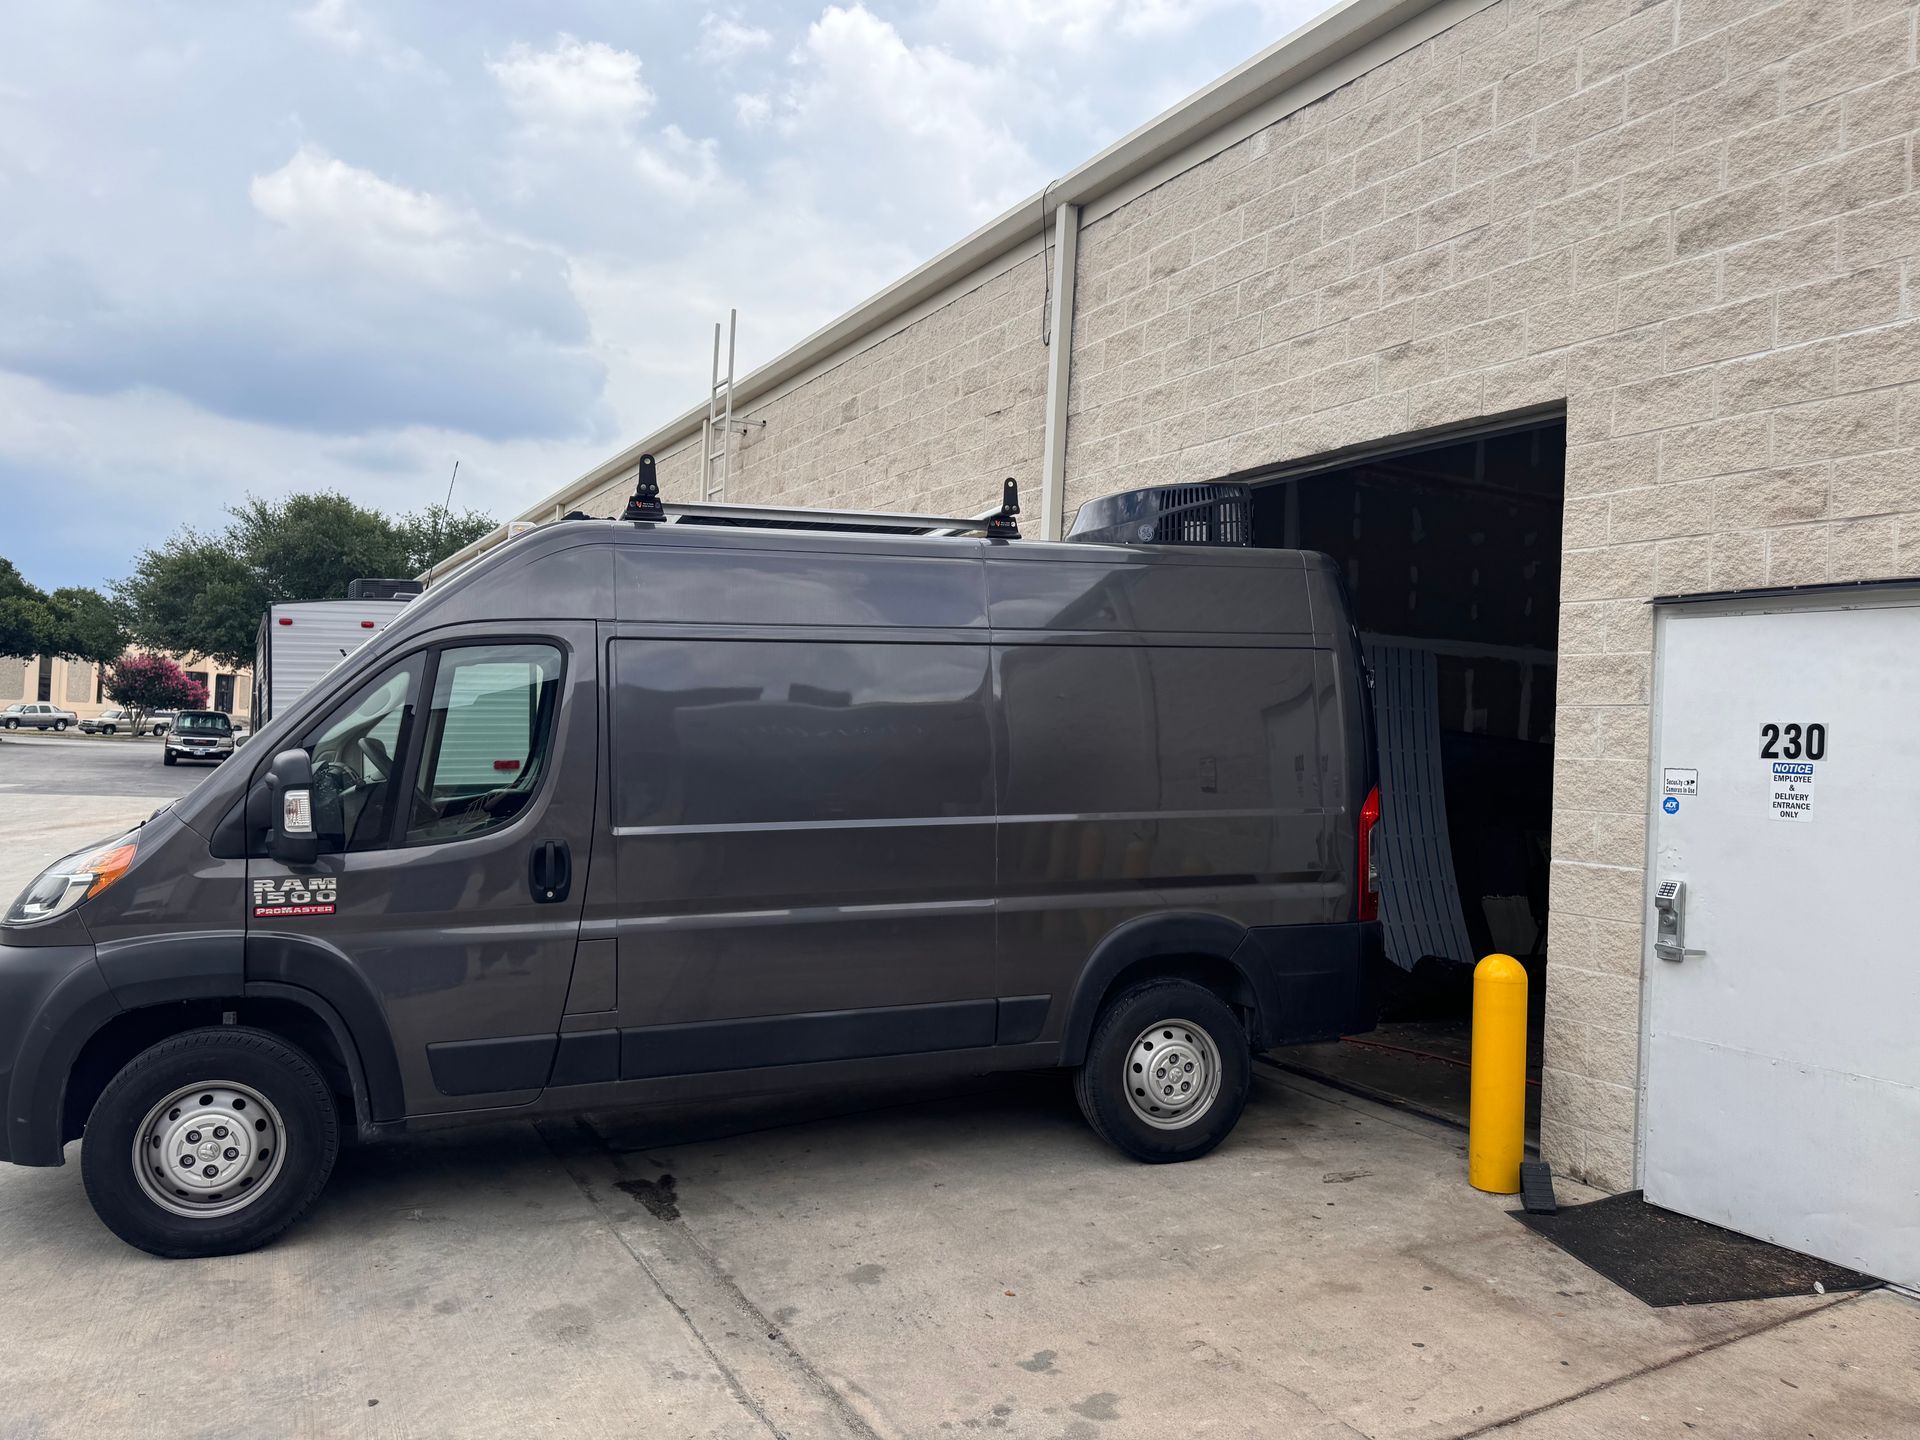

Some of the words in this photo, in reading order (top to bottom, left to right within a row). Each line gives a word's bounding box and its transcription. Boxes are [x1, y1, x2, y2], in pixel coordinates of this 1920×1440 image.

[1760, 723, 1826, 760] 230
[1774, 763, 1813, 774] NOTICE
[1773, 774, 1812, 783] EMPLOYEE
[1774, 793, 1809, 801] DELIVERY
[1772, 801, 1811, 811] ENTRANCE
[1779, 810, 1799, 818] ONLY
[253, 878, 337, 892] RAM
[253, 890, 337, 904] 1500
[256, 905, 333, 915] PROMASTER
